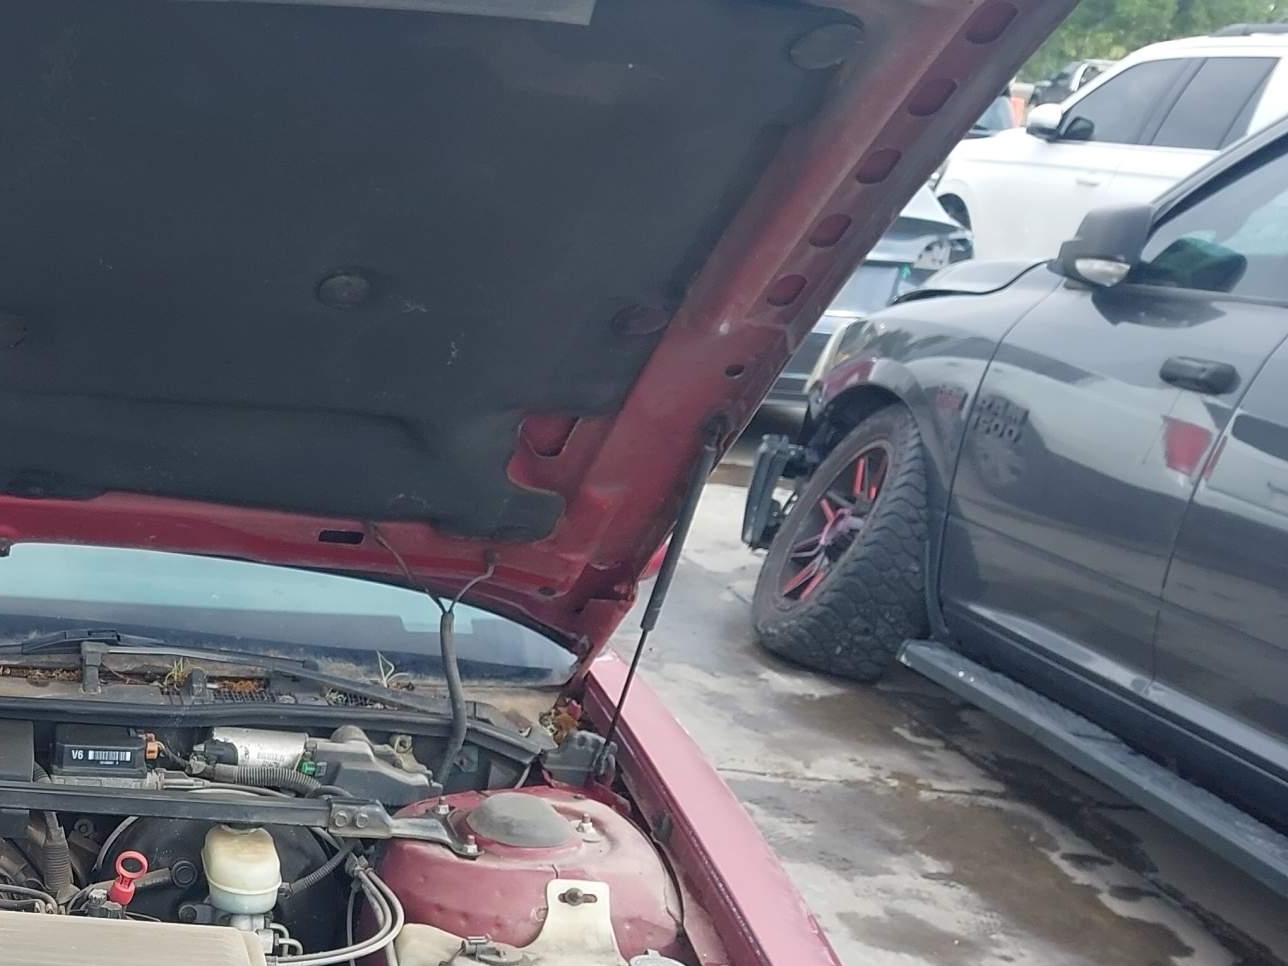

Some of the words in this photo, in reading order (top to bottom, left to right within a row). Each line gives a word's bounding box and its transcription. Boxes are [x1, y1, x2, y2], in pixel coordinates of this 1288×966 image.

[975, 396, 1029, 424] RAM
[972, 414, 1023, 444] 1500
[71, 749, 84, 760] V6
